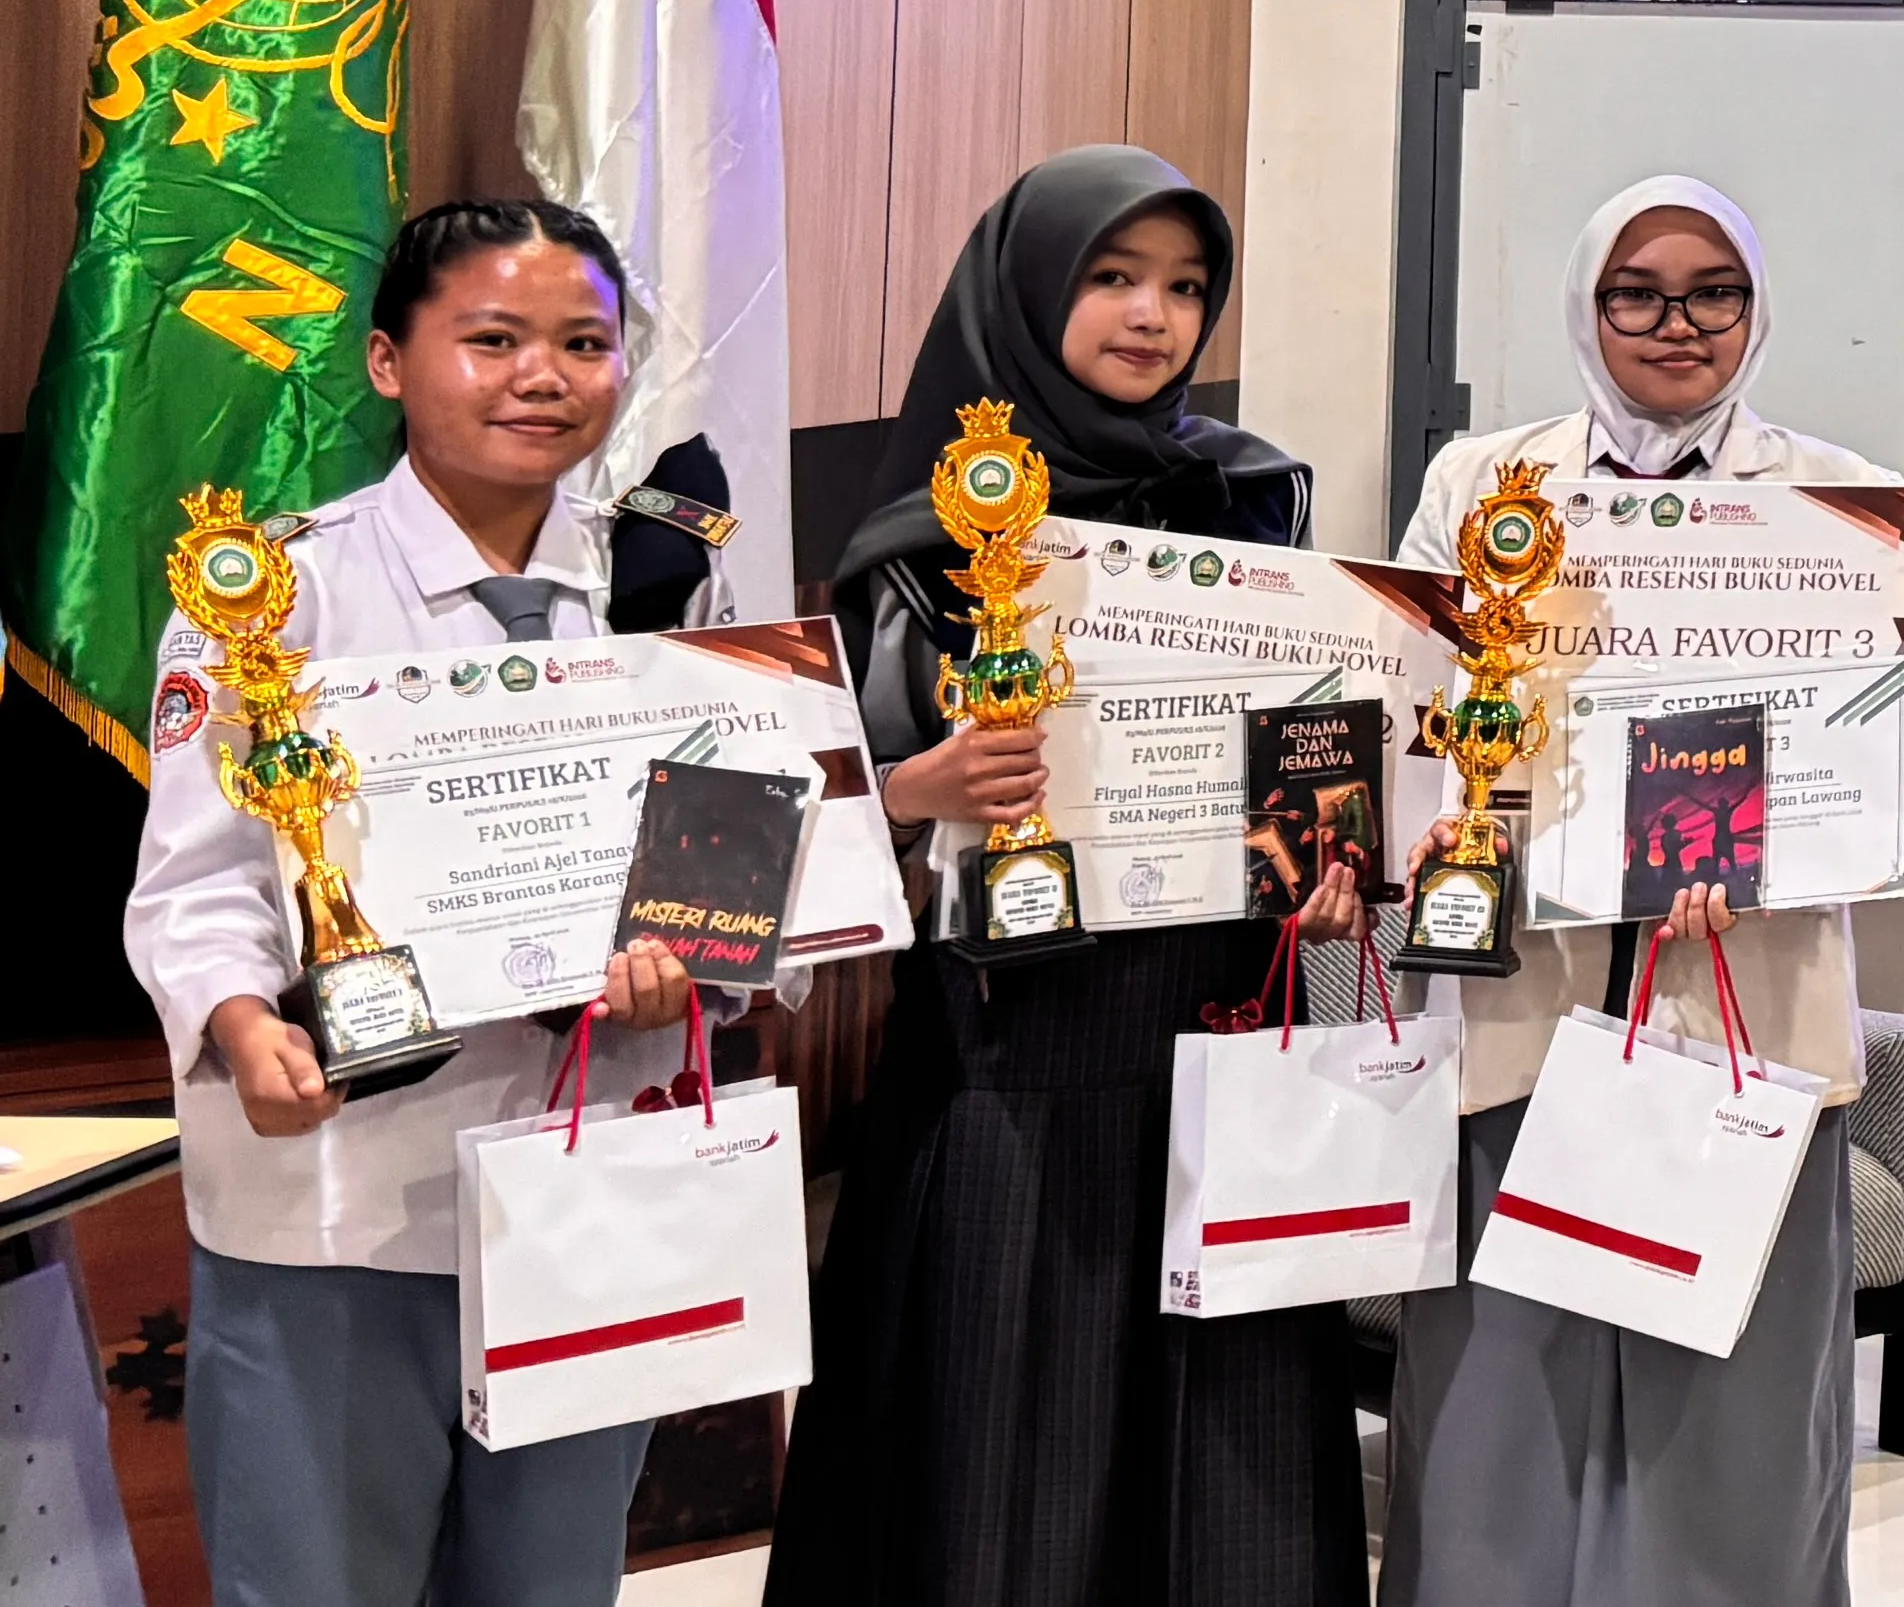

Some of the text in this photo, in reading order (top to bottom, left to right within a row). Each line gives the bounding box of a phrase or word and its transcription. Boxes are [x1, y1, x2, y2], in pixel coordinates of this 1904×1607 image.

[1567, 555, 1844, 570] MEMPERINGATI HARI BUKU SEDUNIA
[1548, 571, 1882, 592] OMBA RESENSI BUKU NOVEL
[1097, 604, 1374, 651] MEMPERINGATI HARI BUKU SEDUNIA
[1053, 615, 1407, 677] LOMBA RESENSI BUKU NOVEL
[1525, 625, 1875, 660] JUARA FAVORIT 3
[1099, 692, 1252, 722] SERTIFIKAT
[414, 701, 739, 748] MEMPERINGATI HARI BUKU SEDUNIA
[1280, 720, 1350, 740] JENAMA
[1131, 741, 1224, 765] FAVORIT 2
[1296, 736, 1333, 753] DAN
[1278, 752, 1354, 772] JEMAWA
[1640, 741, 1748, 776] Jingga
[427, 756, 612, 805] SERTIFIKAT
[1094, 779, 1192, 803] Firyal Hasna
[1800, 786, 1862, 805] Lawang
[477, 811, 591, 843] FAVORIT 1
[629, 900, 705, 930] MISTERI
[708, 910, 778, 936] RUANG
[695, 1136, 761, 1159] bankjatim
